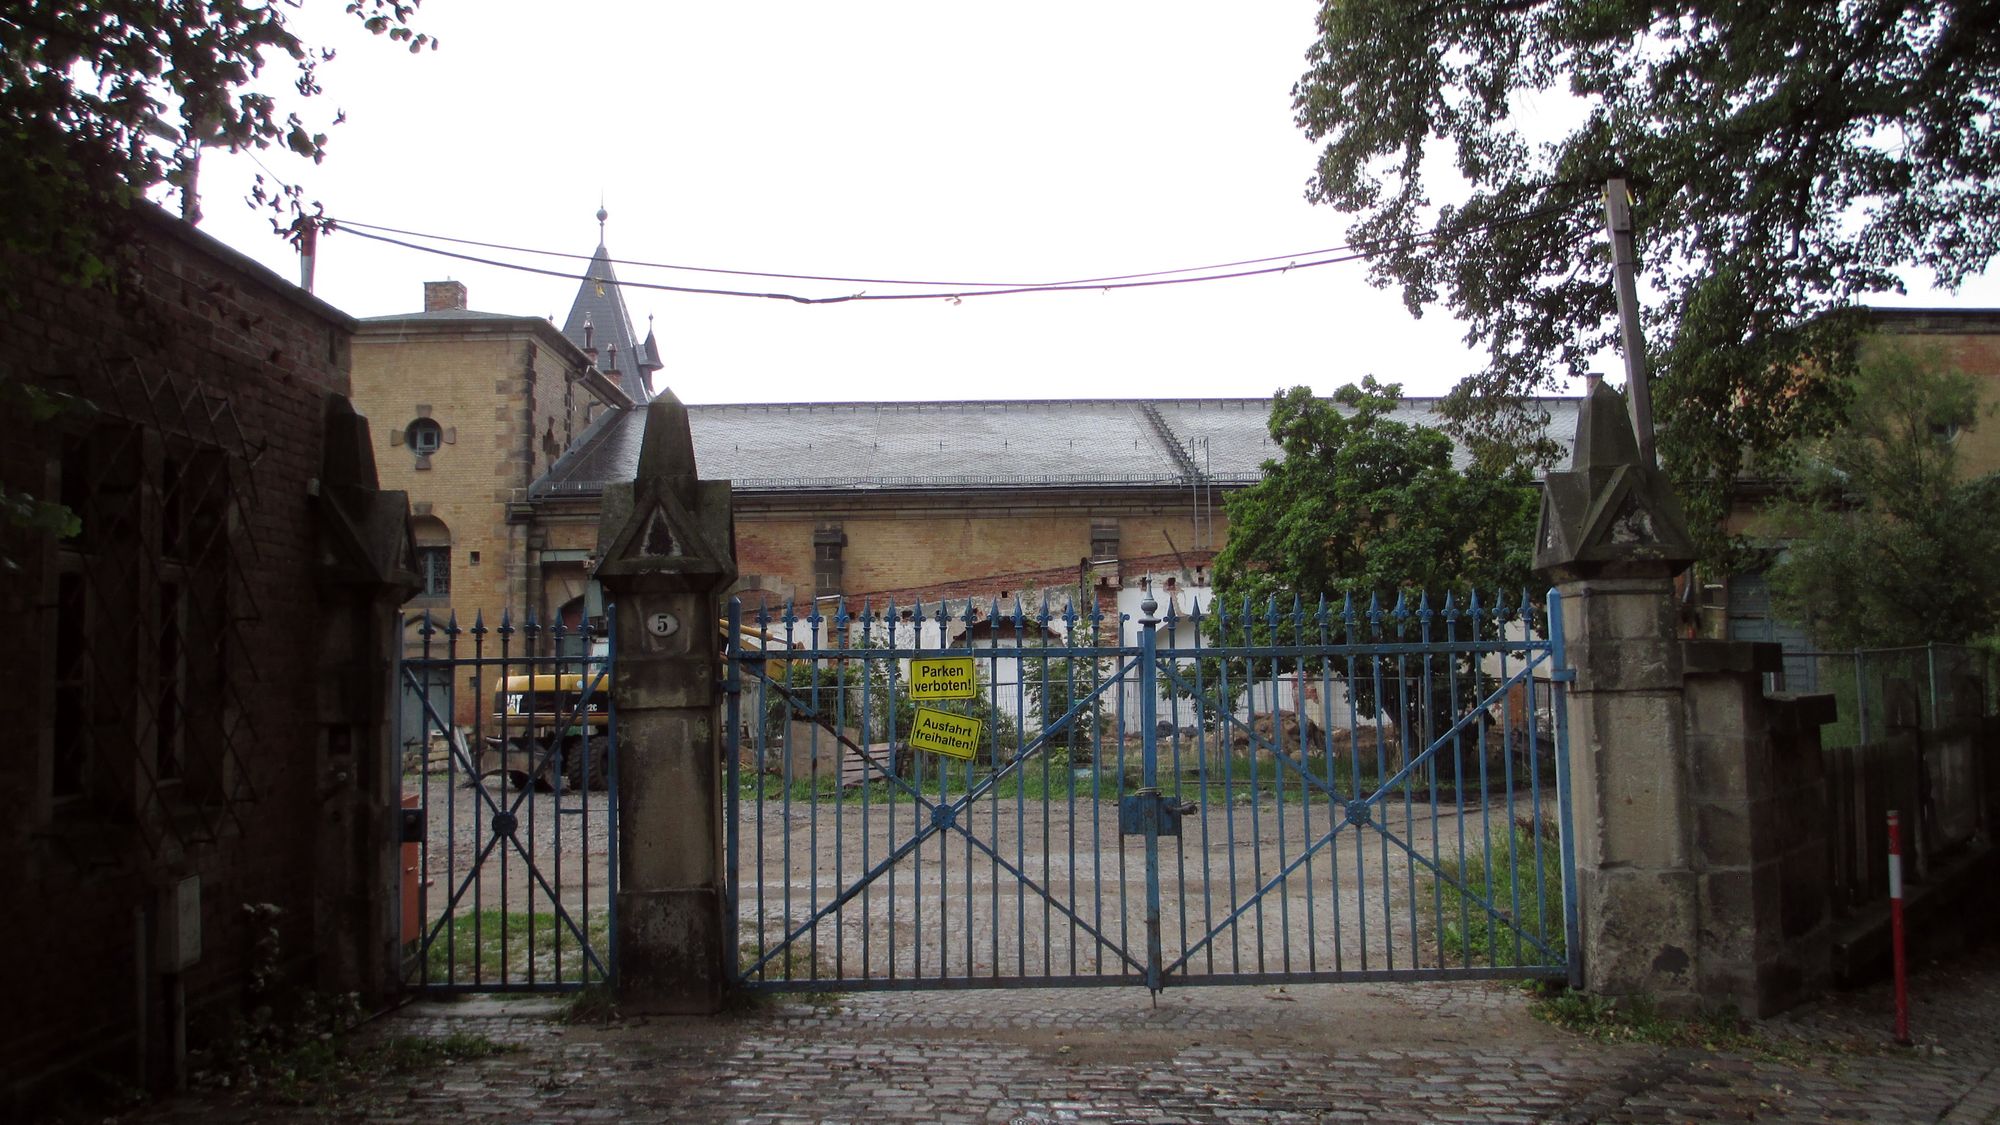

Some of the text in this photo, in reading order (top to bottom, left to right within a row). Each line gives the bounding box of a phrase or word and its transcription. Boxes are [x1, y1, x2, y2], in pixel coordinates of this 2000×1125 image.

[657, 615, 668, 632] 5
[922, 665, 964, 677] Parken
[914, 678, 971, 692] verboten!
[923, 718, 972, 737] Ausfahrt
[916, 729, 974, 750] freihalten!
